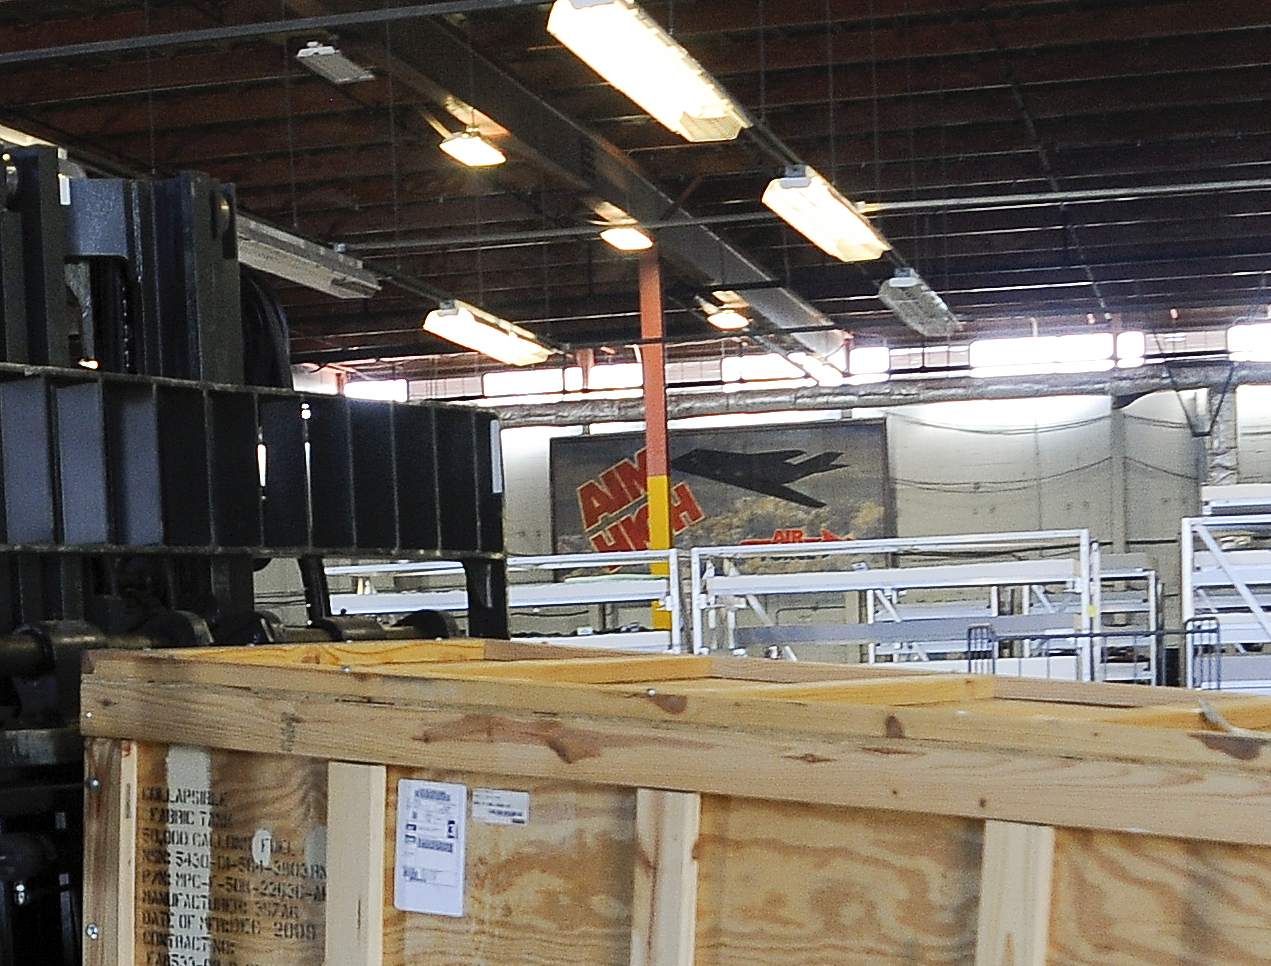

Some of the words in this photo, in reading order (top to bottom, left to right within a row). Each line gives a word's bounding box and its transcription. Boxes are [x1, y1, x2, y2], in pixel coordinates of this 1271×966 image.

[773, 529, 804, 543] AIR
[142, 786, 227, 807] COLLAPSIBLE
[149, 807, 194, 825] FABRIC
[142, 910, 174, 929] DATE
[178, 914, 196, 930] OF
[142, 931, 209, 952] CONTRACT
